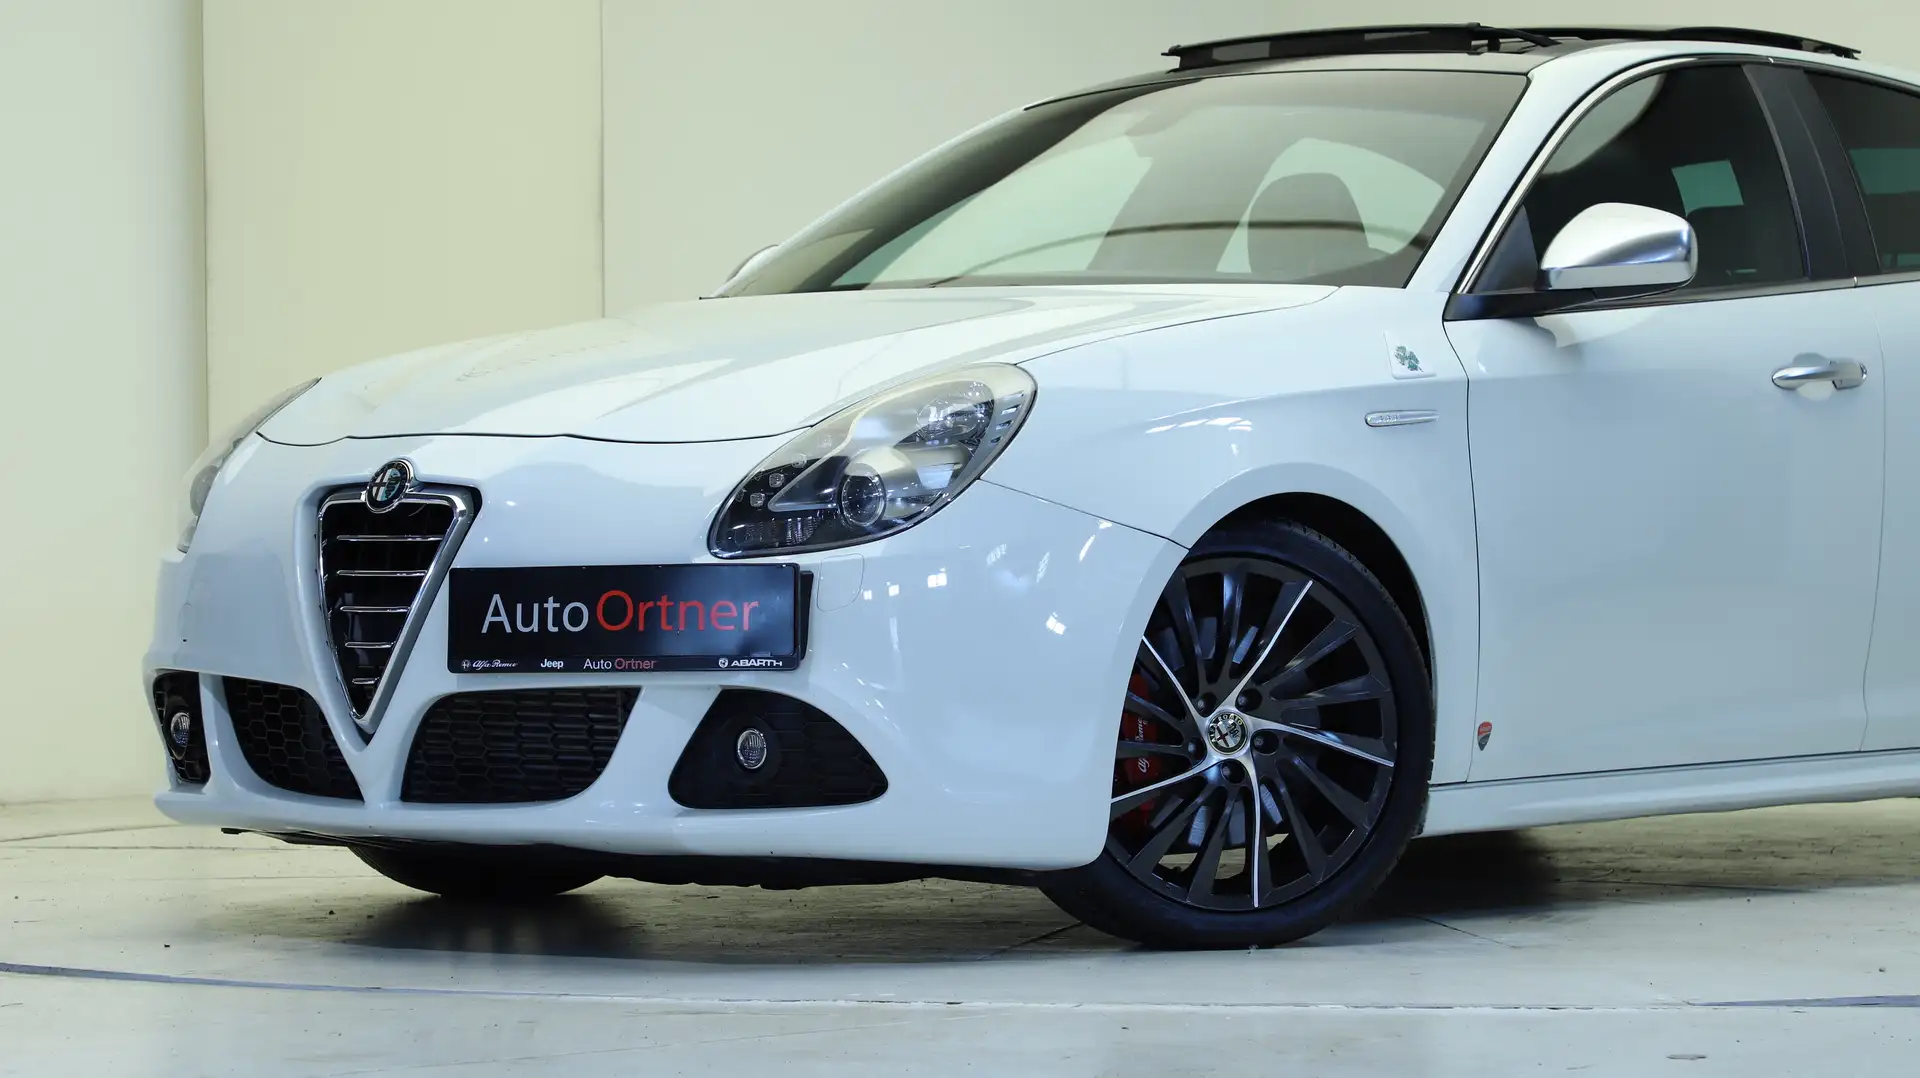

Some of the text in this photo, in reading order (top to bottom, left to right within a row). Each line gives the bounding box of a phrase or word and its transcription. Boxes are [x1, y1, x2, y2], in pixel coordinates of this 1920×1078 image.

[481, 590, 760, 634] Auto Ortner
[540, 658, 564, 670] Jeep
[583, 658, 657, 670] Auto Ortner
[730, 658, 783, 667] ABARTH
